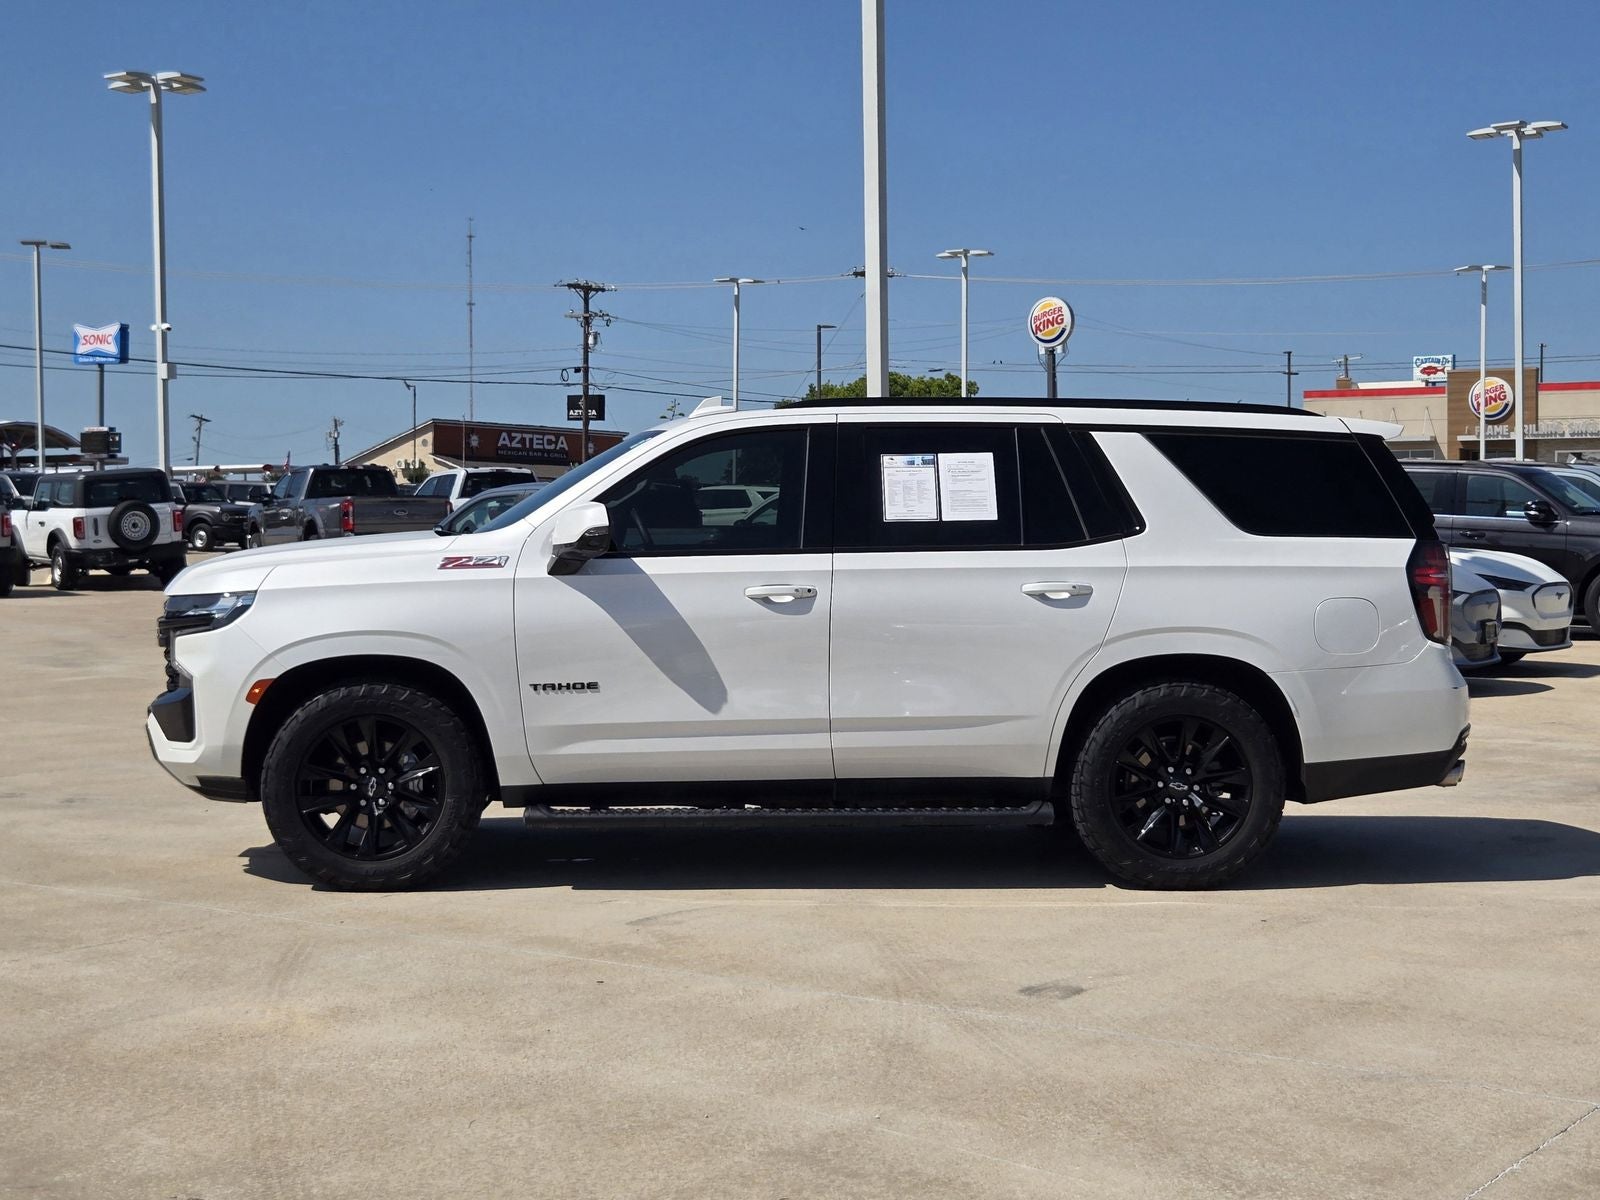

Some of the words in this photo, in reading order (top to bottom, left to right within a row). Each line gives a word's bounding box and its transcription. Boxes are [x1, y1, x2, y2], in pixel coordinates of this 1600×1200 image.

[1033, 306, 1063, 324] BURGER
[1034, 313, 1064, 335] KING
[81, 333, 112, 346] SONIC
[1474, 384, 1505, 402] BRGER
[1475, 424, 1509, 436] FAME
[498, 431, 568, 451] AZTECA
[498, 449, 527, 457] MEXICAN
[437, 555, 510, 570] Z71
[529, 681, 599, 692] TAHOE
